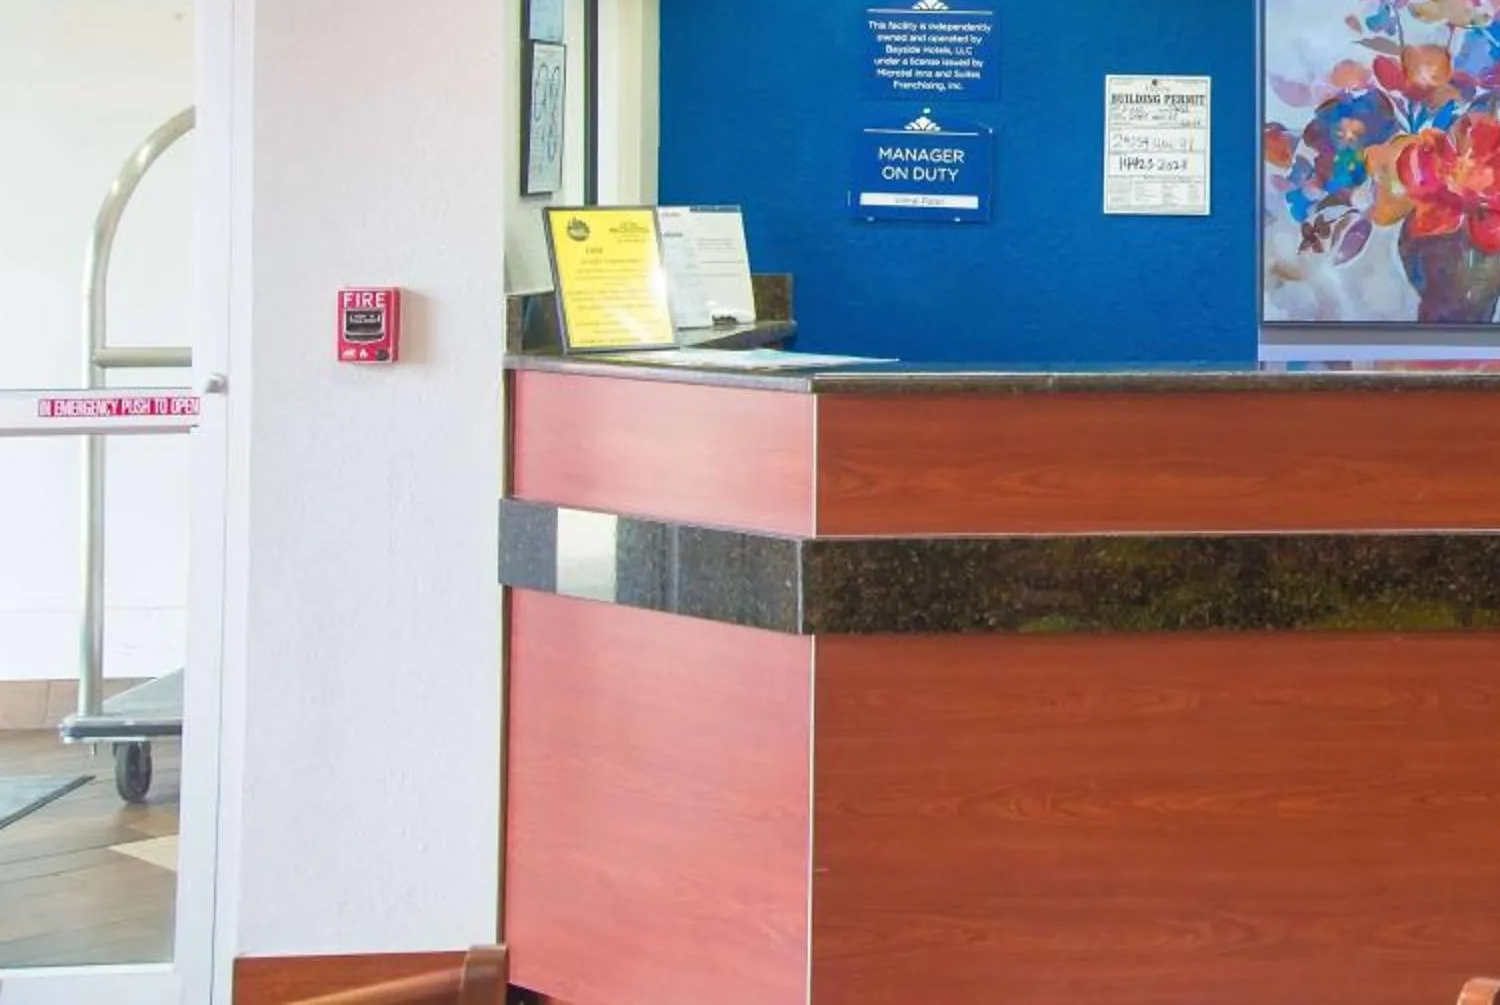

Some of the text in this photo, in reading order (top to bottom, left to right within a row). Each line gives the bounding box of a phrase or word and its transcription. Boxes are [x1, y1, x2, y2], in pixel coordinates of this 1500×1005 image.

[868, 20, 992, 33] This facility is independently
[877, 33, 982, 44] owned and operated by
[885, 45, 921, 55] Bayside
[955, 46, 973, 55] LLC
[874, 56, 984, 68] under a license issued by
[934, 69, 952, 78] and
[954, 69, 981, 79] Suites
[1111, 93, 1206, 105] BUILDING PERMIT
[878, 147, 965, 164] MANAGER
[881, 165, 959, 182] ON DUTY
[344, 292, 385, 308] FIRE
[54, 398, 118, 416] EMERGENCY
[121, 397, 150, 416] PUSH
[155, 397, 168, 415] TO
[171, 397, 200, 415] OPEN
